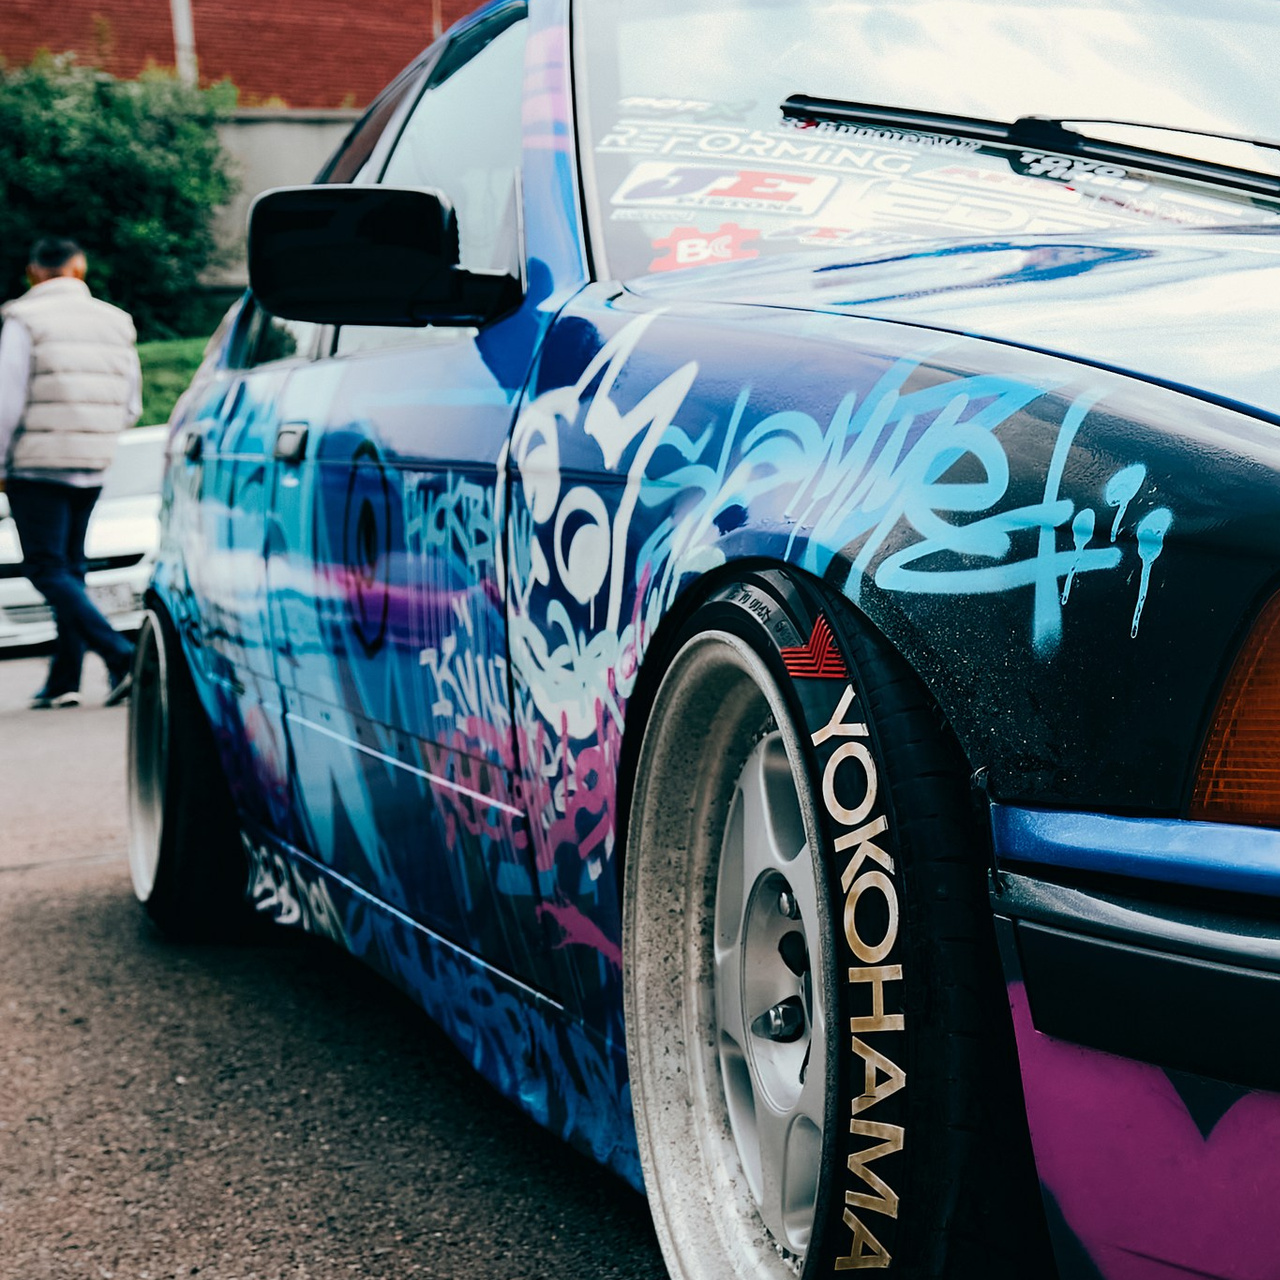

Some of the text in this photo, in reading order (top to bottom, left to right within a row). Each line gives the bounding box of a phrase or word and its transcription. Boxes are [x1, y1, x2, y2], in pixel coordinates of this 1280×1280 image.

[1020, 151, 1127, 178] TOYO
[624, 168, 817, 202] JE
[810, 683, 906, 1271] YOKOHAMA
